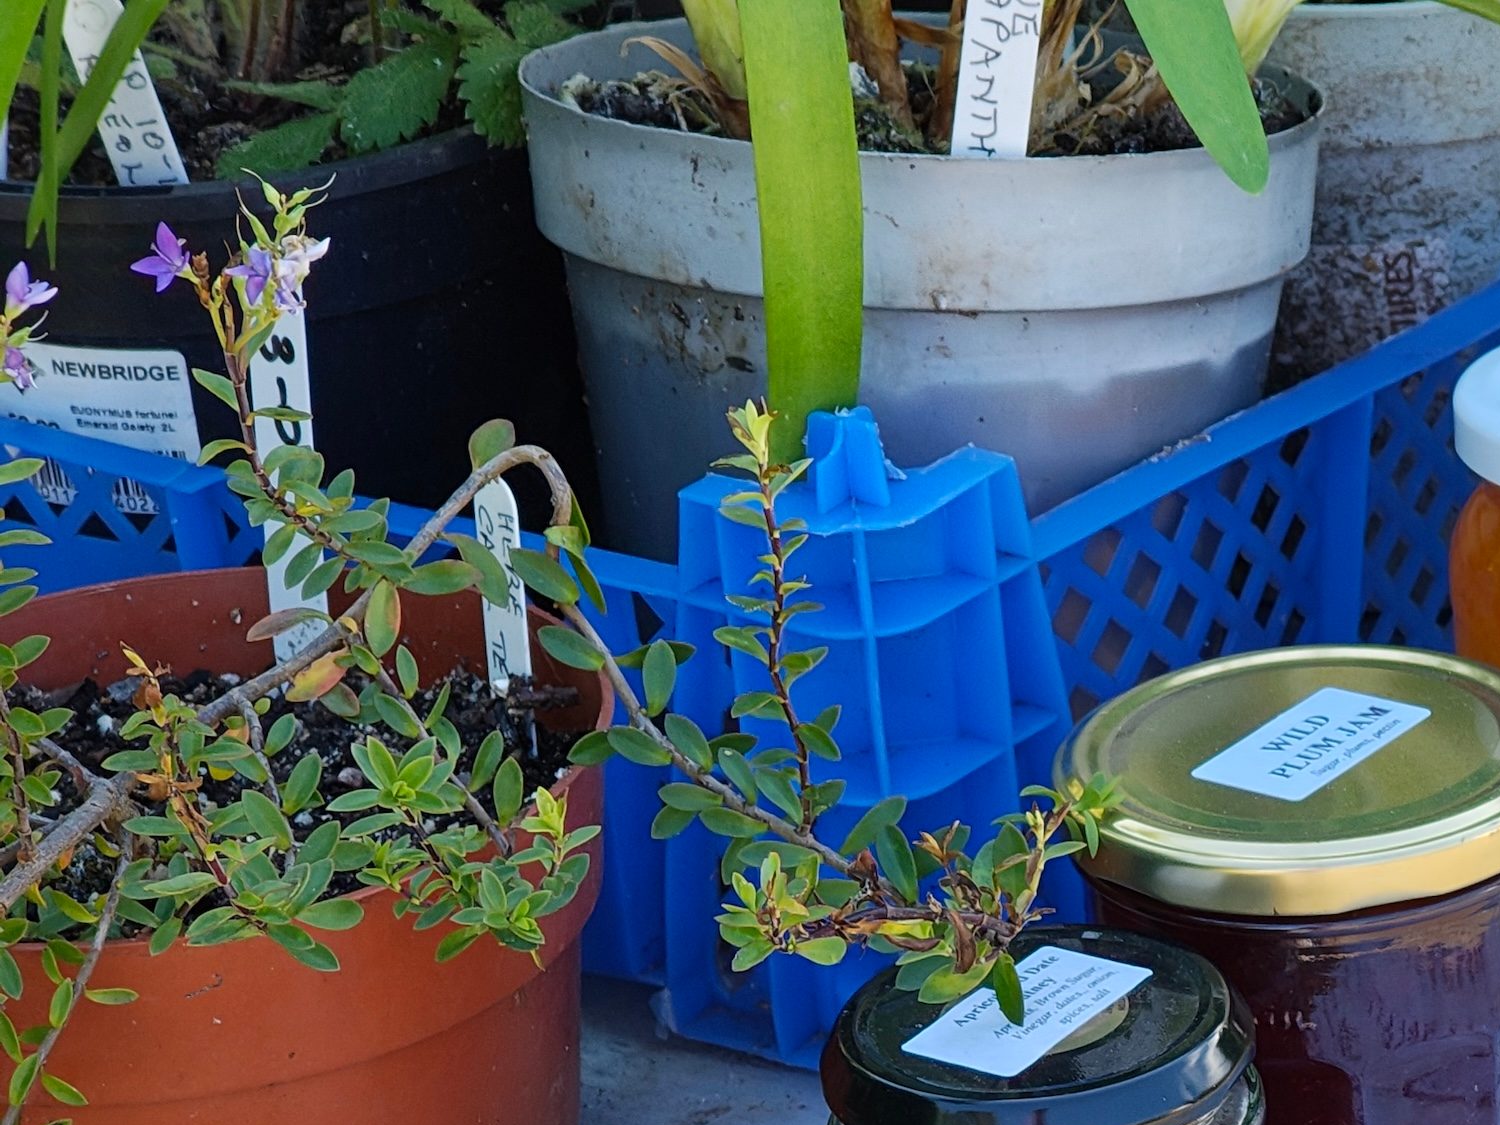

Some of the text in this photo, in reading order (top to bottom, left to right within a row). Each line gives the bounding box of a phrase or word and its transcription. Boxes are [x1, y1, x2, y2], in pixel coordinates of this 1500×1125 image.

[52, 359, 180, 381] NEWBRIDGE
[1261, 715, 1330, 752] WILD
[1268, 705, 1394, 779] PLUM JAM
[953, 956, 1061, 1027] Aprico Date
[1034, 984, 1071, 1007] Brown
